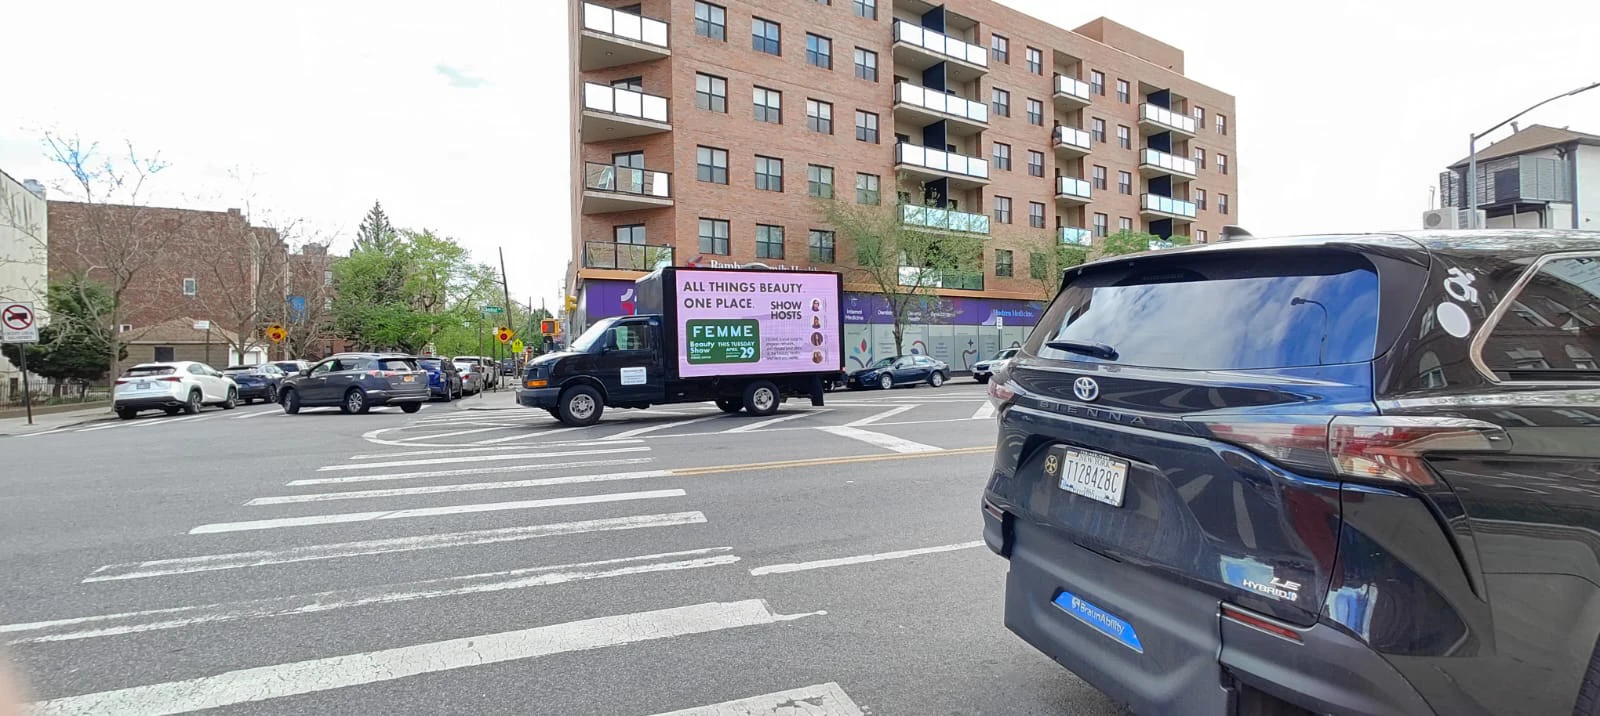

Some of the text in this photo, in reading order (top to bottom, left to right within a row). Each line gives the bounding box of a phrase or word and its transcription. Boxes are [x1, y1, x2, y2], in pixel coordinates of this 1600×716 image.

[683, 281, 705, 292] ALL
[709, 281, 756, 293] THINGS
[684, 297, 755, 309] ONE PLACE.
[770, 300, 802, 310] SHOW
[770, 310, 802, 320] HOSTS
[693, 325, 753, 338] FEMME
[690, 340, 715, 349] Beauty
[740, 346, 755, 358] 29
[1039, 401, 1145, 424] SIENNA
[1066, 460, 1120, 494] T128428C
[1243, 579, 1288, 599] HYBRID
[1270, 576, 1302, 591] LE
[1079, 602, 1126, 636] BraunAbility
